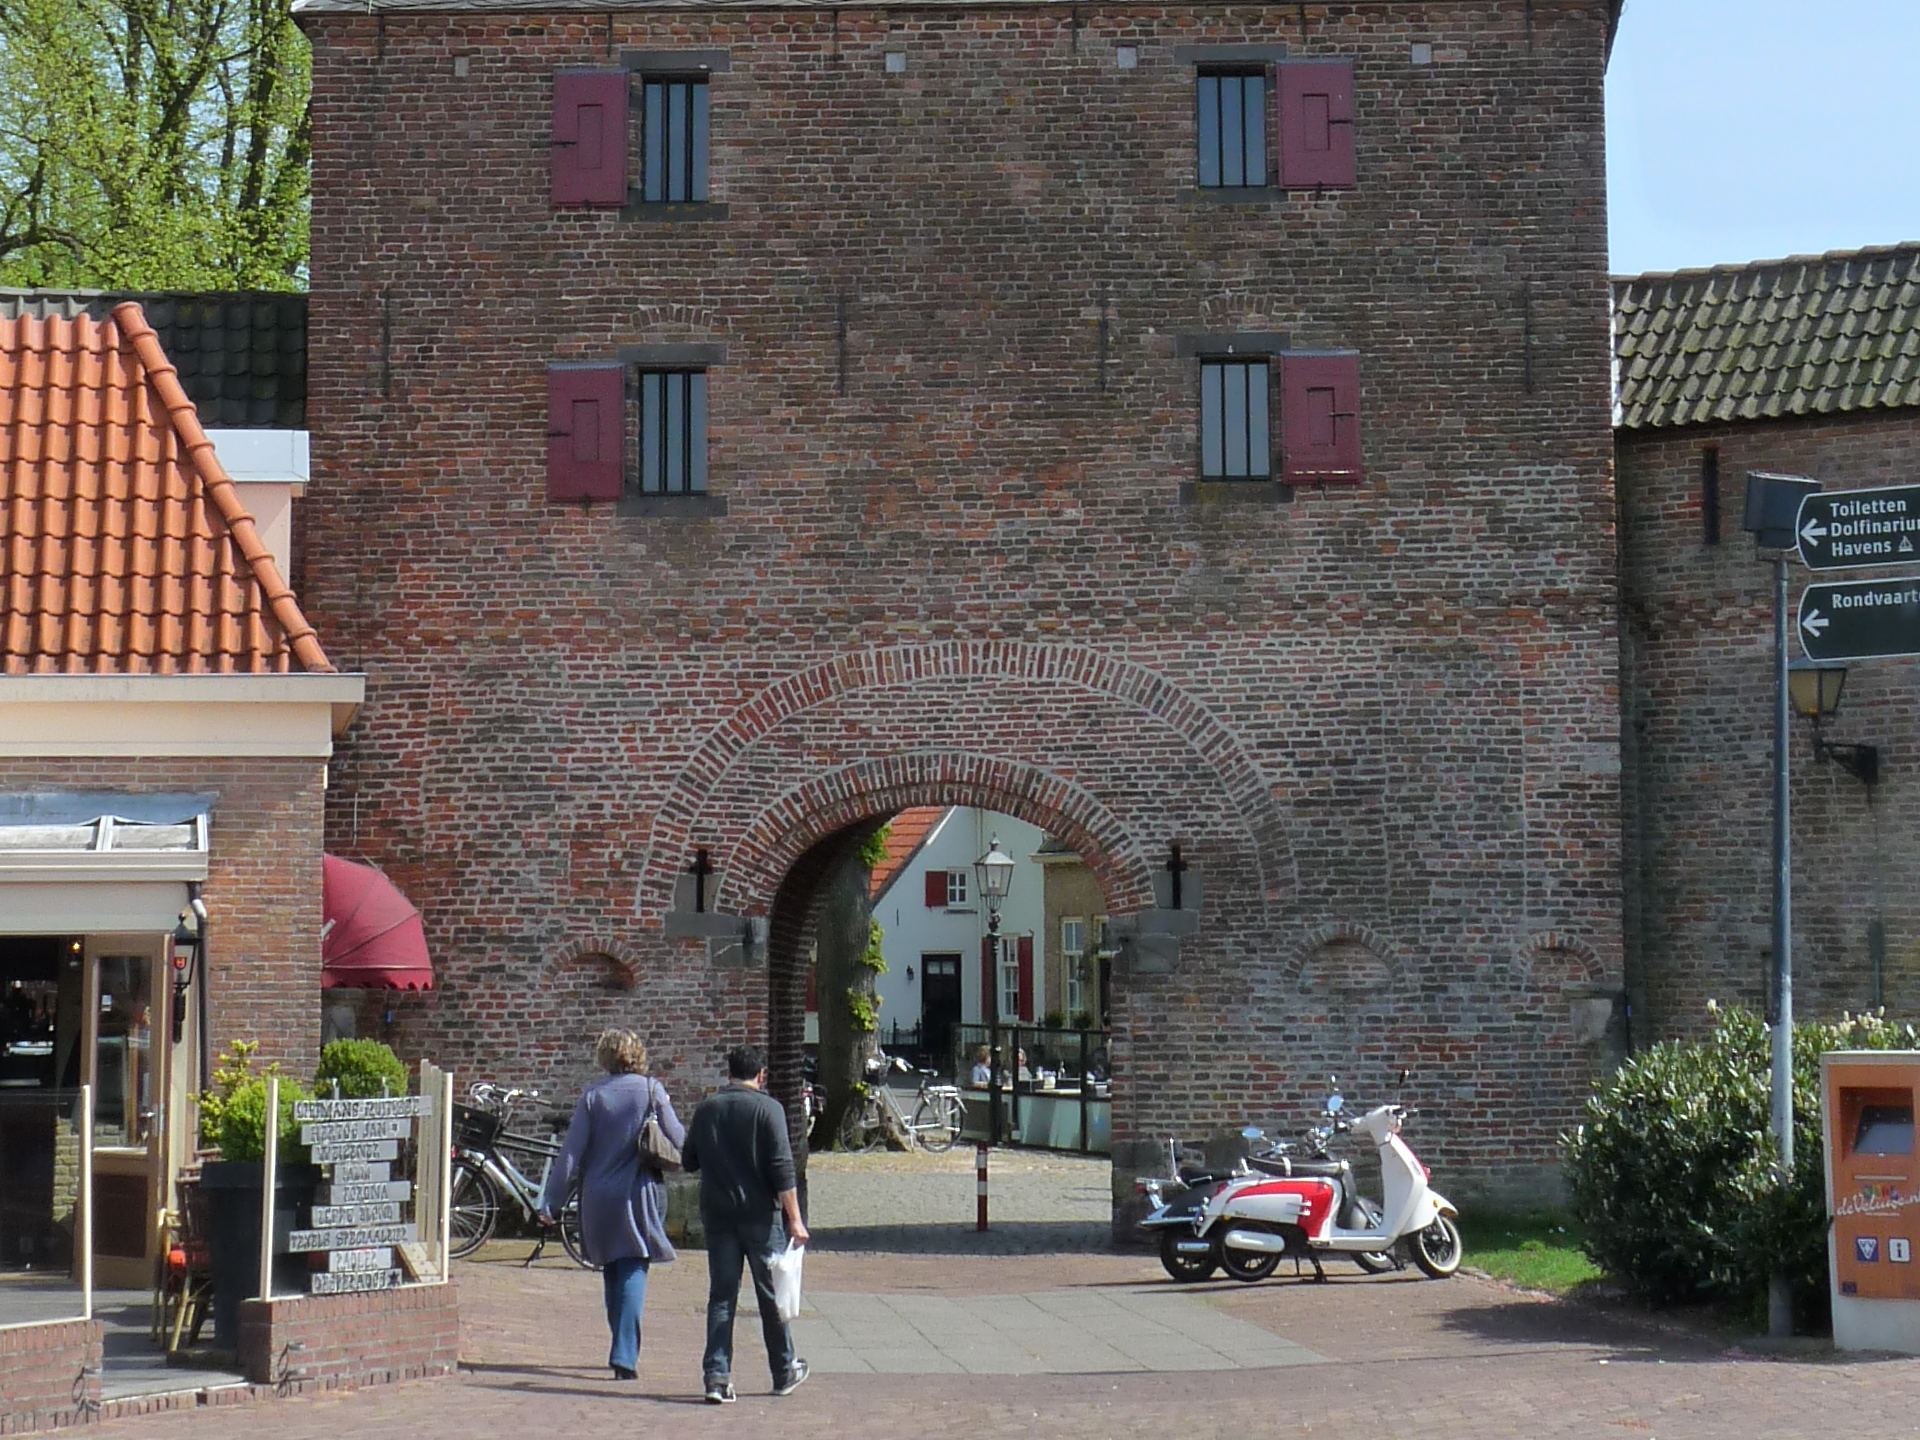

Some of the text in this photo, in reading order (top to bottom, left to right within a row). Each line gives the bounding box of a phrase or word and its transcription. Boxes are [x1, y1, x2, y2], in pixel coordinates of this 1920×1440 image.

[1830, 500, 1906, 517] Toiletten
[1832, 541, 1892, 557] Havens
[1832, 589, 1920, 609] Rondvaart
[363, 1121, 386, 1139] JAN
[291, 1231, 330, 1249] TEXELS
